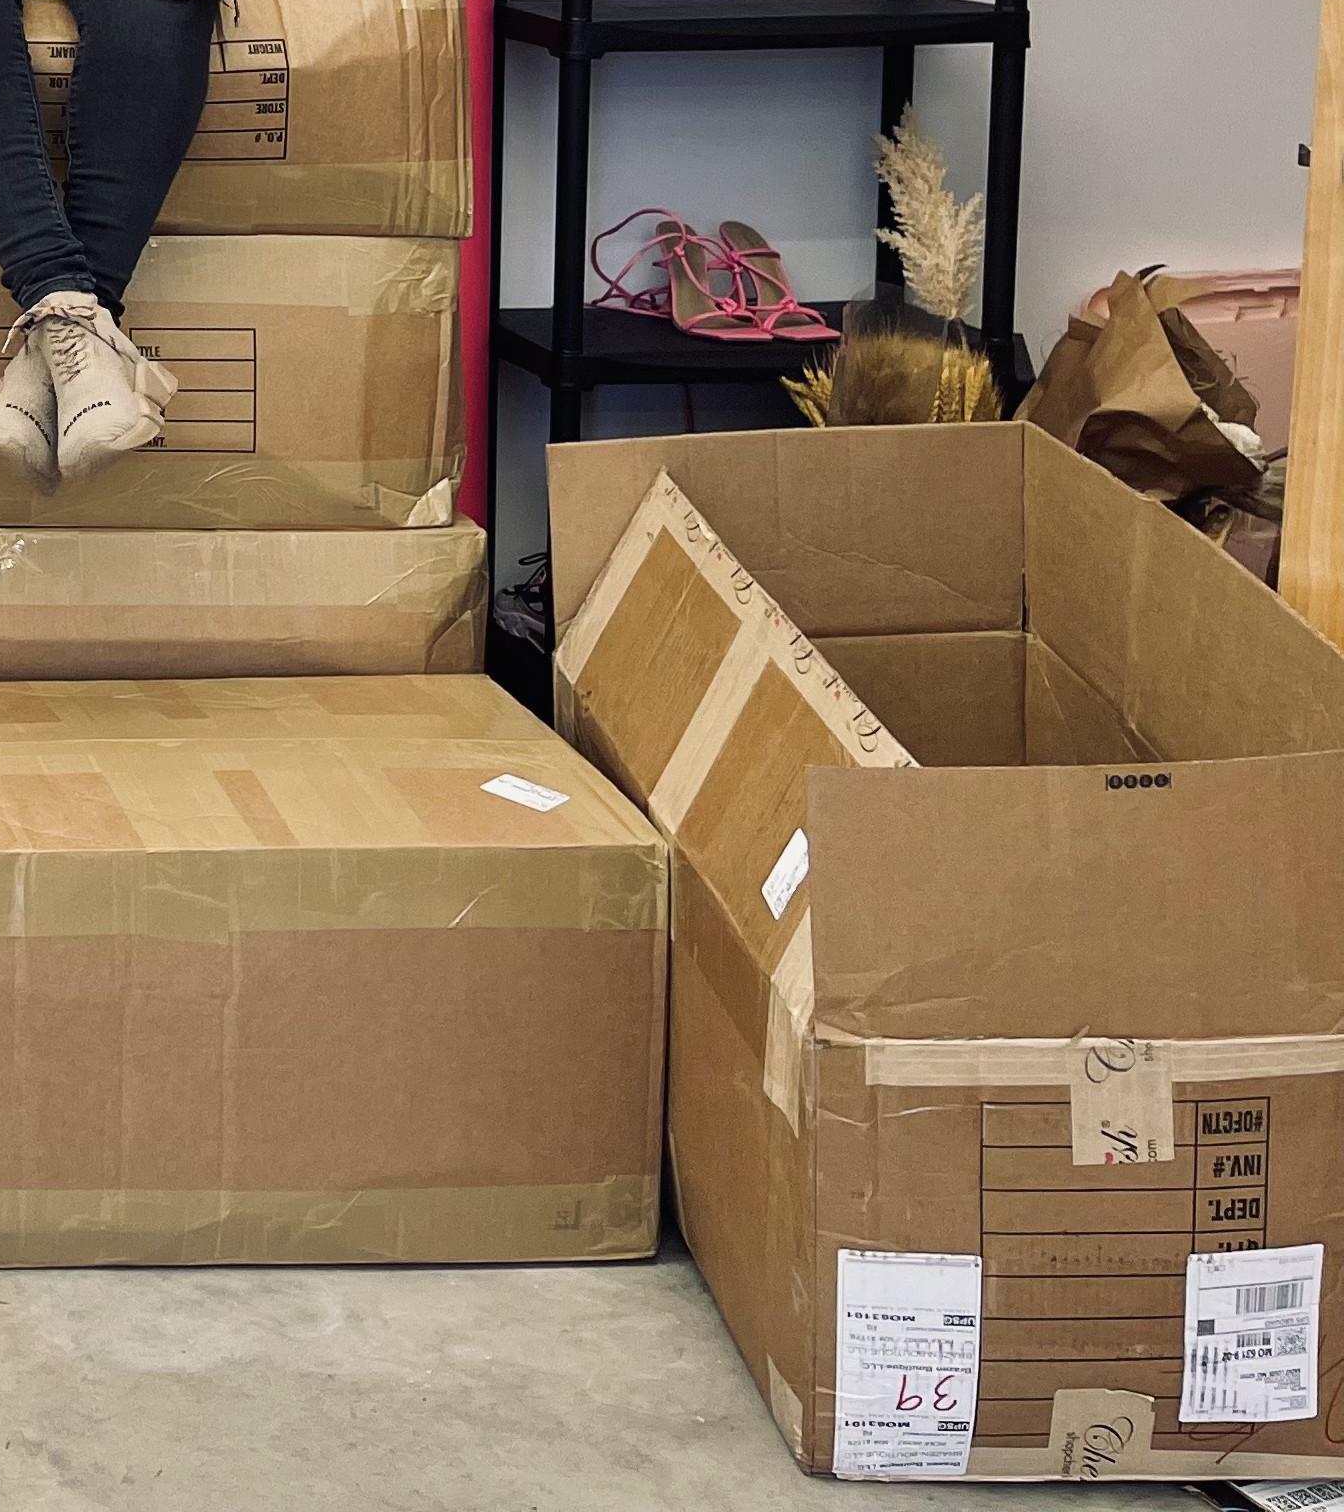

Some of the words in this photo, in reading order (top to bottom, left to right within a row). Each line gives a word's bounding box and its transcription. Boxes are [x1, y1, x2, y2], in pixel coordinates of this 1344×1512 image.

[47, 46, 76, 59] UANT.
[248, 43, 283, 55] WEIGHT
[49, 77, 69, 89] LOR
[255, 103, 285, 114] STORE
[140, 436, 167, 448] ANT.
[1208, 1197, 1260, 1221] DEPT.
